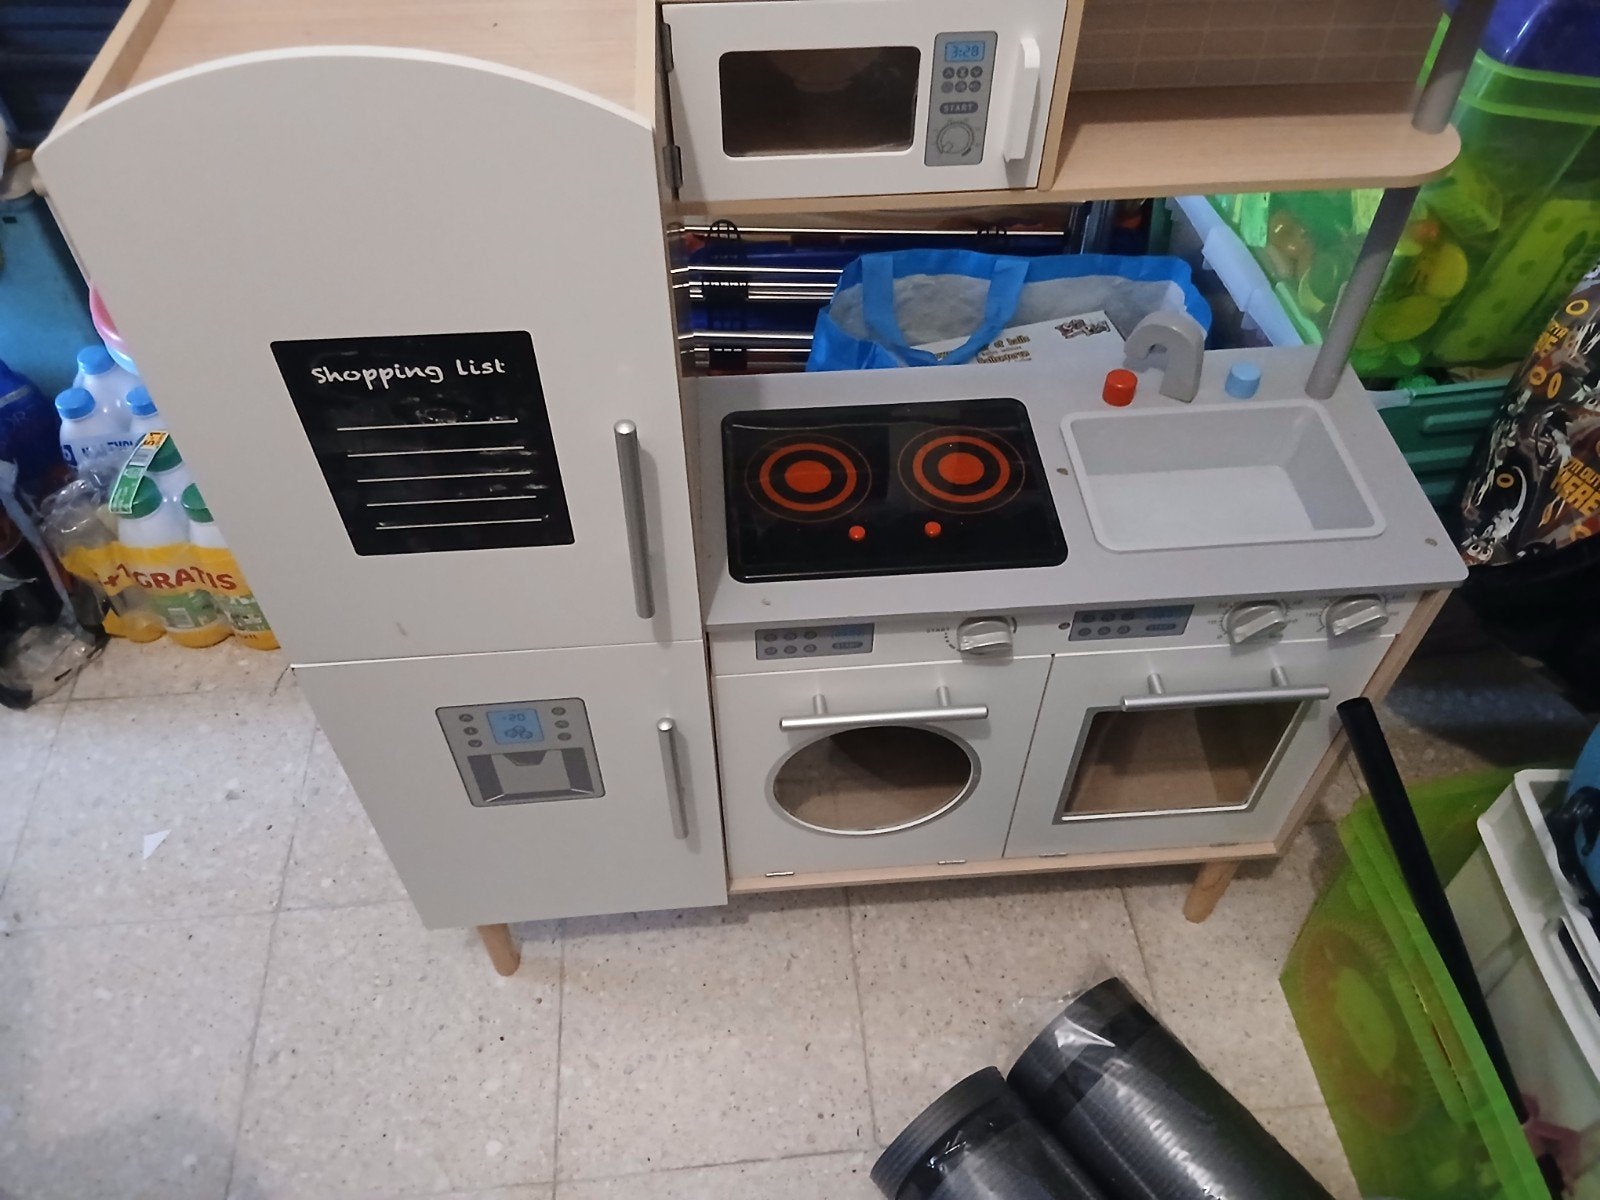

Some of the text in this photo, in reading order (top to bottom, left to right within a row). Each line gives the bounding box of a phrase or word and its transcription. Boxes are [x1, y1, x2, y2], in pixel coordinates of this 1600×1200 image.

[943, 103, 974, 114] START
[311, 362, 444, 390] Shopping
[133, 565, 237, 591] GRATIS
